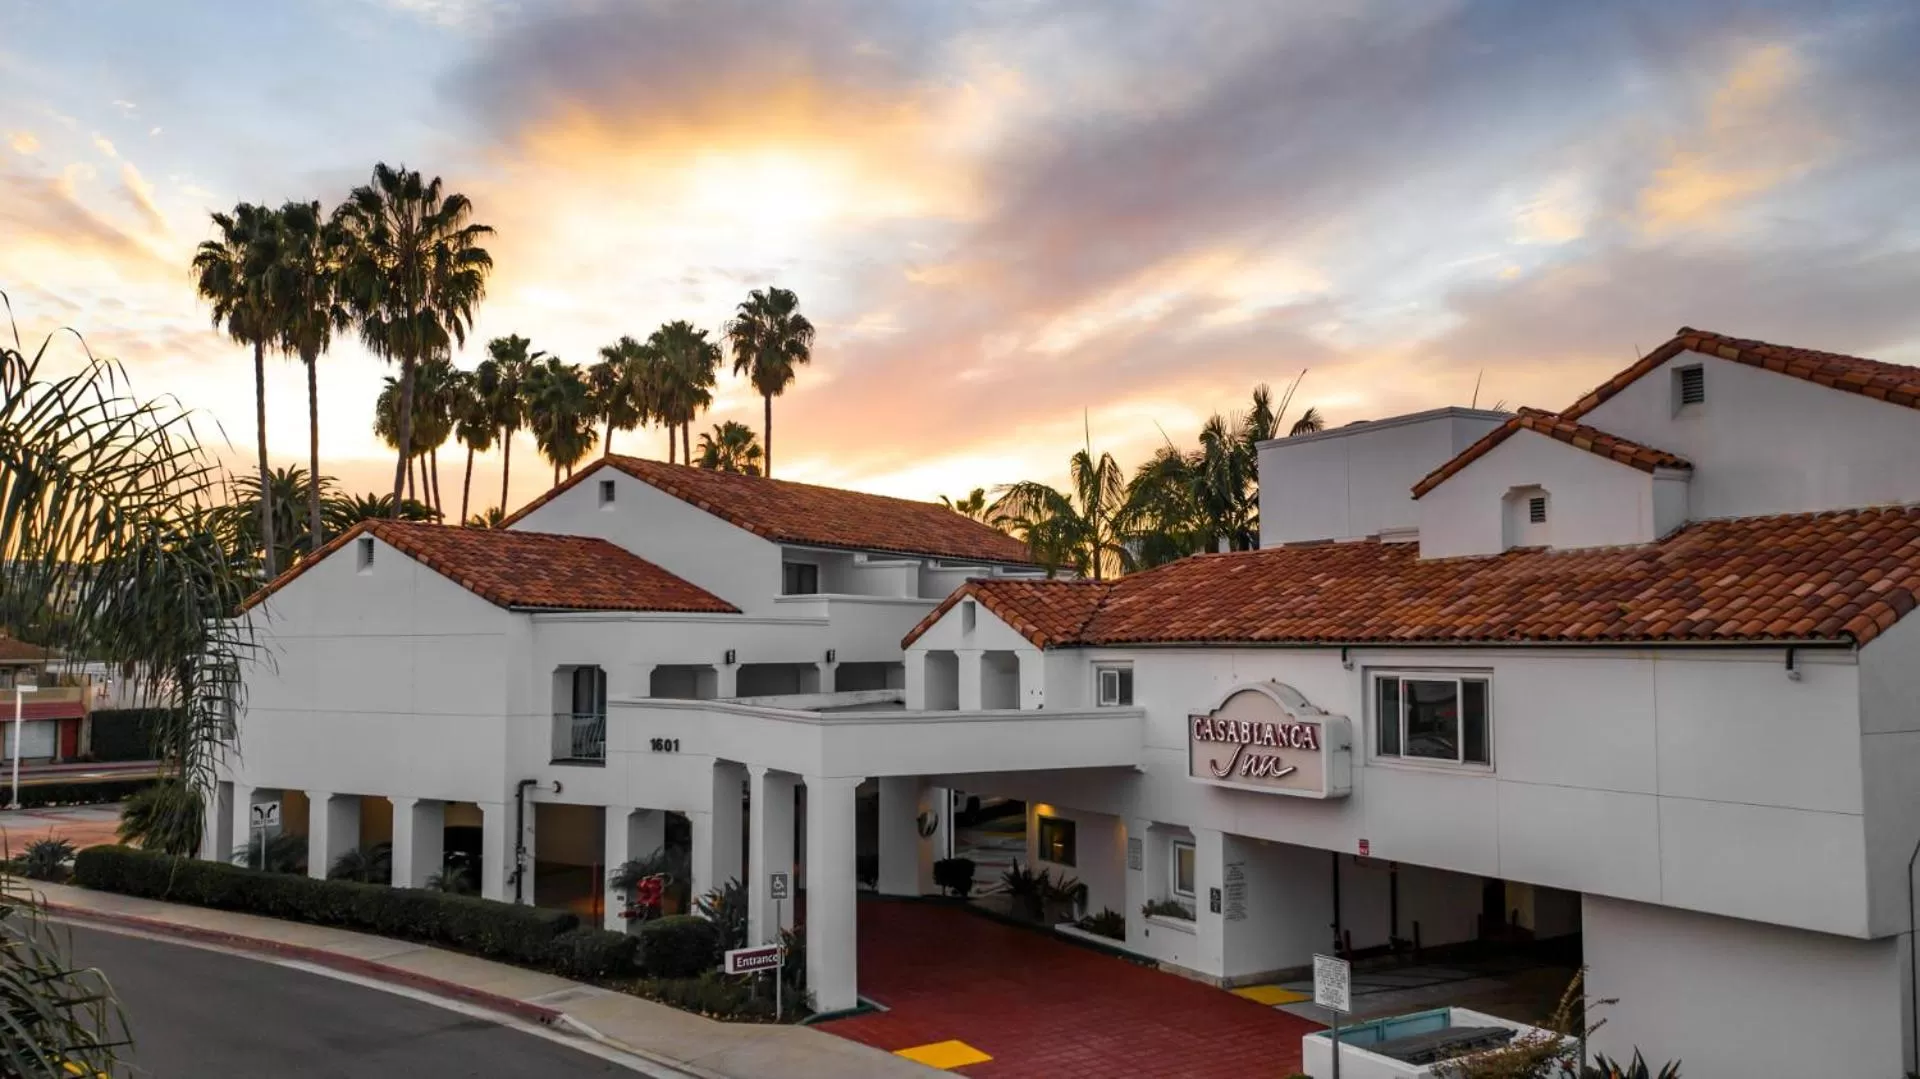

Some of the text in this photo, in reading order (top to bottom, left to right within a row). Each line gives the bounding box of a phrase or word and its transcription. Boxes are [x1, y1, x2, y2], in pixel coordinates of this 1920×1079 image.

[649, 737, 680, 752] 1601
[1193, 718, 1319, 751] CASABLANCA
[1210, 744, 1297, 779] Inn
